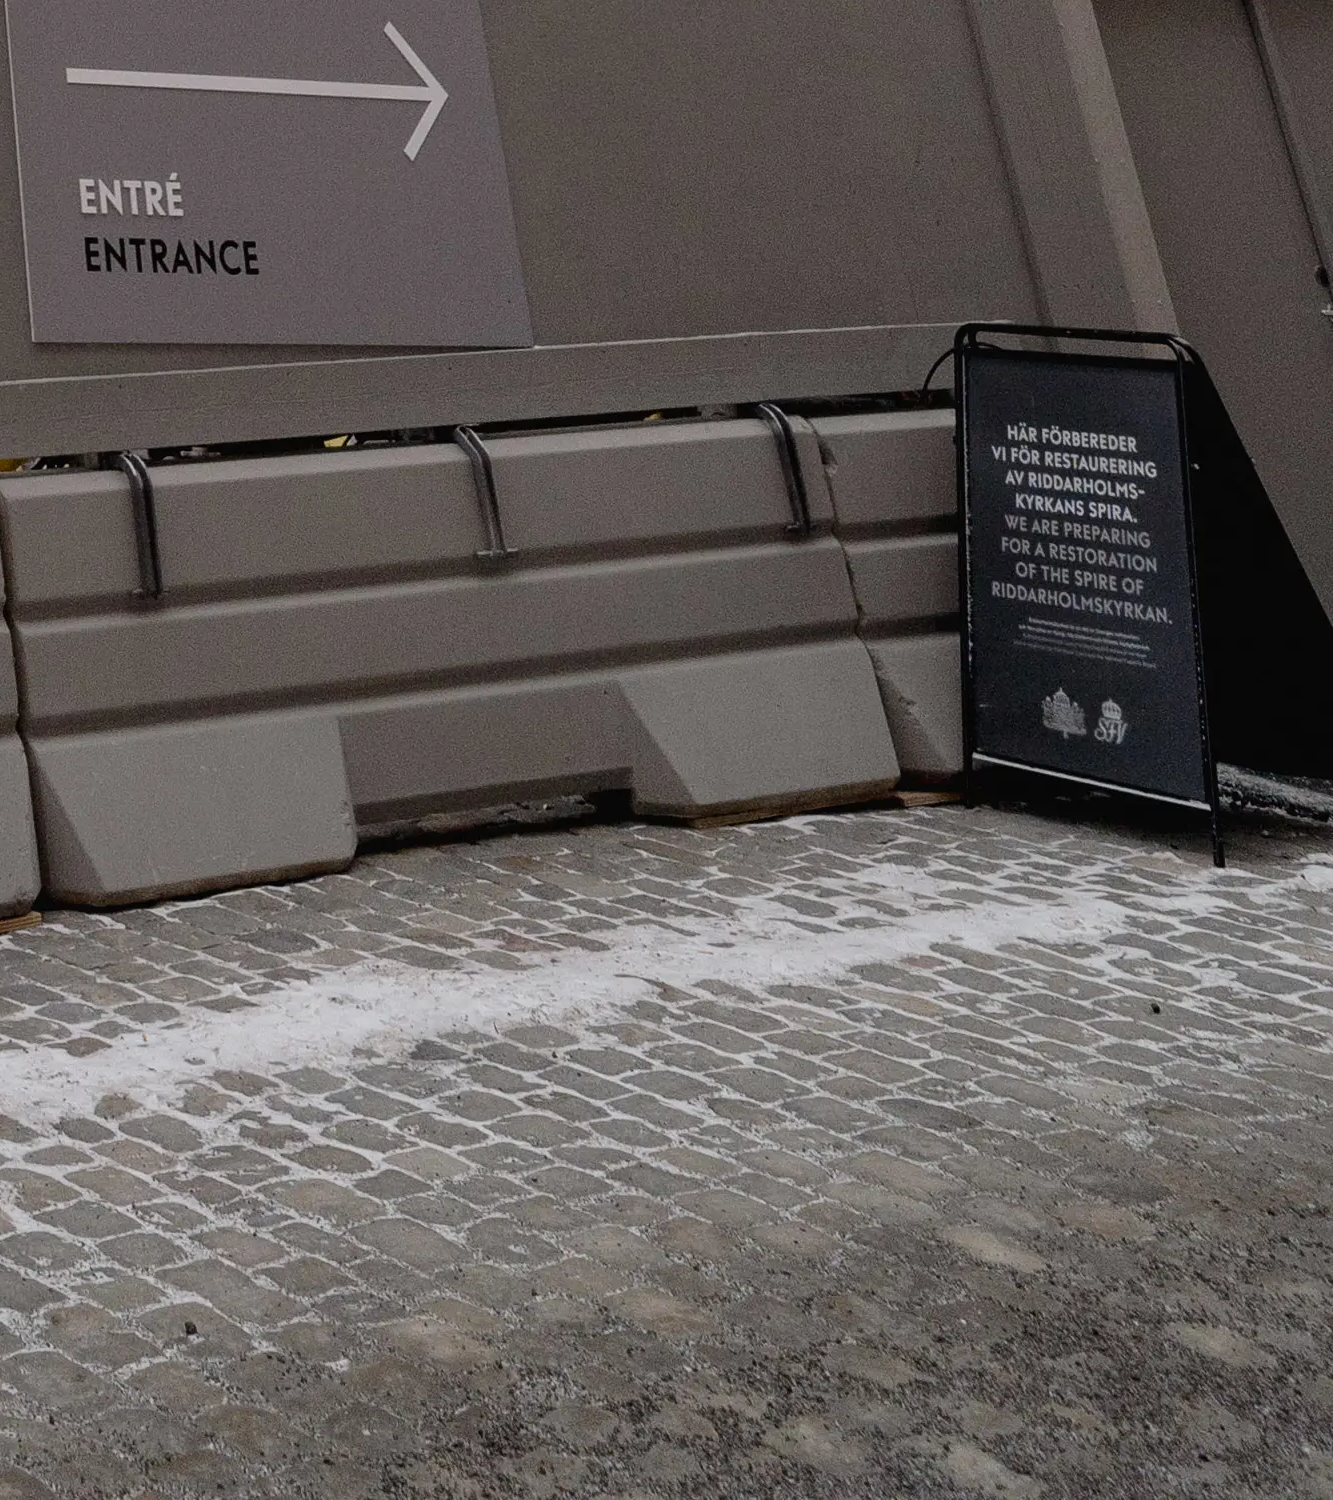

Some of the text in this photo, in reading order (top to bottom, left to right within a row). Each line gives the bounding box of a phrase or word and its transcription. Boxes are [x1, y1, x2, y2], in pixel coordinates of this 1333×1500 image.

[78, 171, 184, 216] ENTRÉ
[84, 236, 260, 276] ENTRANCE
[1006, 422, 1137, 453] HÄR FÖRBEREDER
[991, 444, 1157, 478] VI FÖR RESTAURERING
[1004, 470, 1145, 500] AV RIDDARHOLMS-
[1015, 493, 1137, 523] KYRKANS SPIRA.
[1004, 514, 1151, 548] WE ARE PREPARING
[1001, 536, 1157, 572] FOR A RESTORATION
[1015, 561, 1144, 595] OF THE SPIRE OF
[991, 581, 1173, 624] RIDDARHOLMSKYRKAN.
